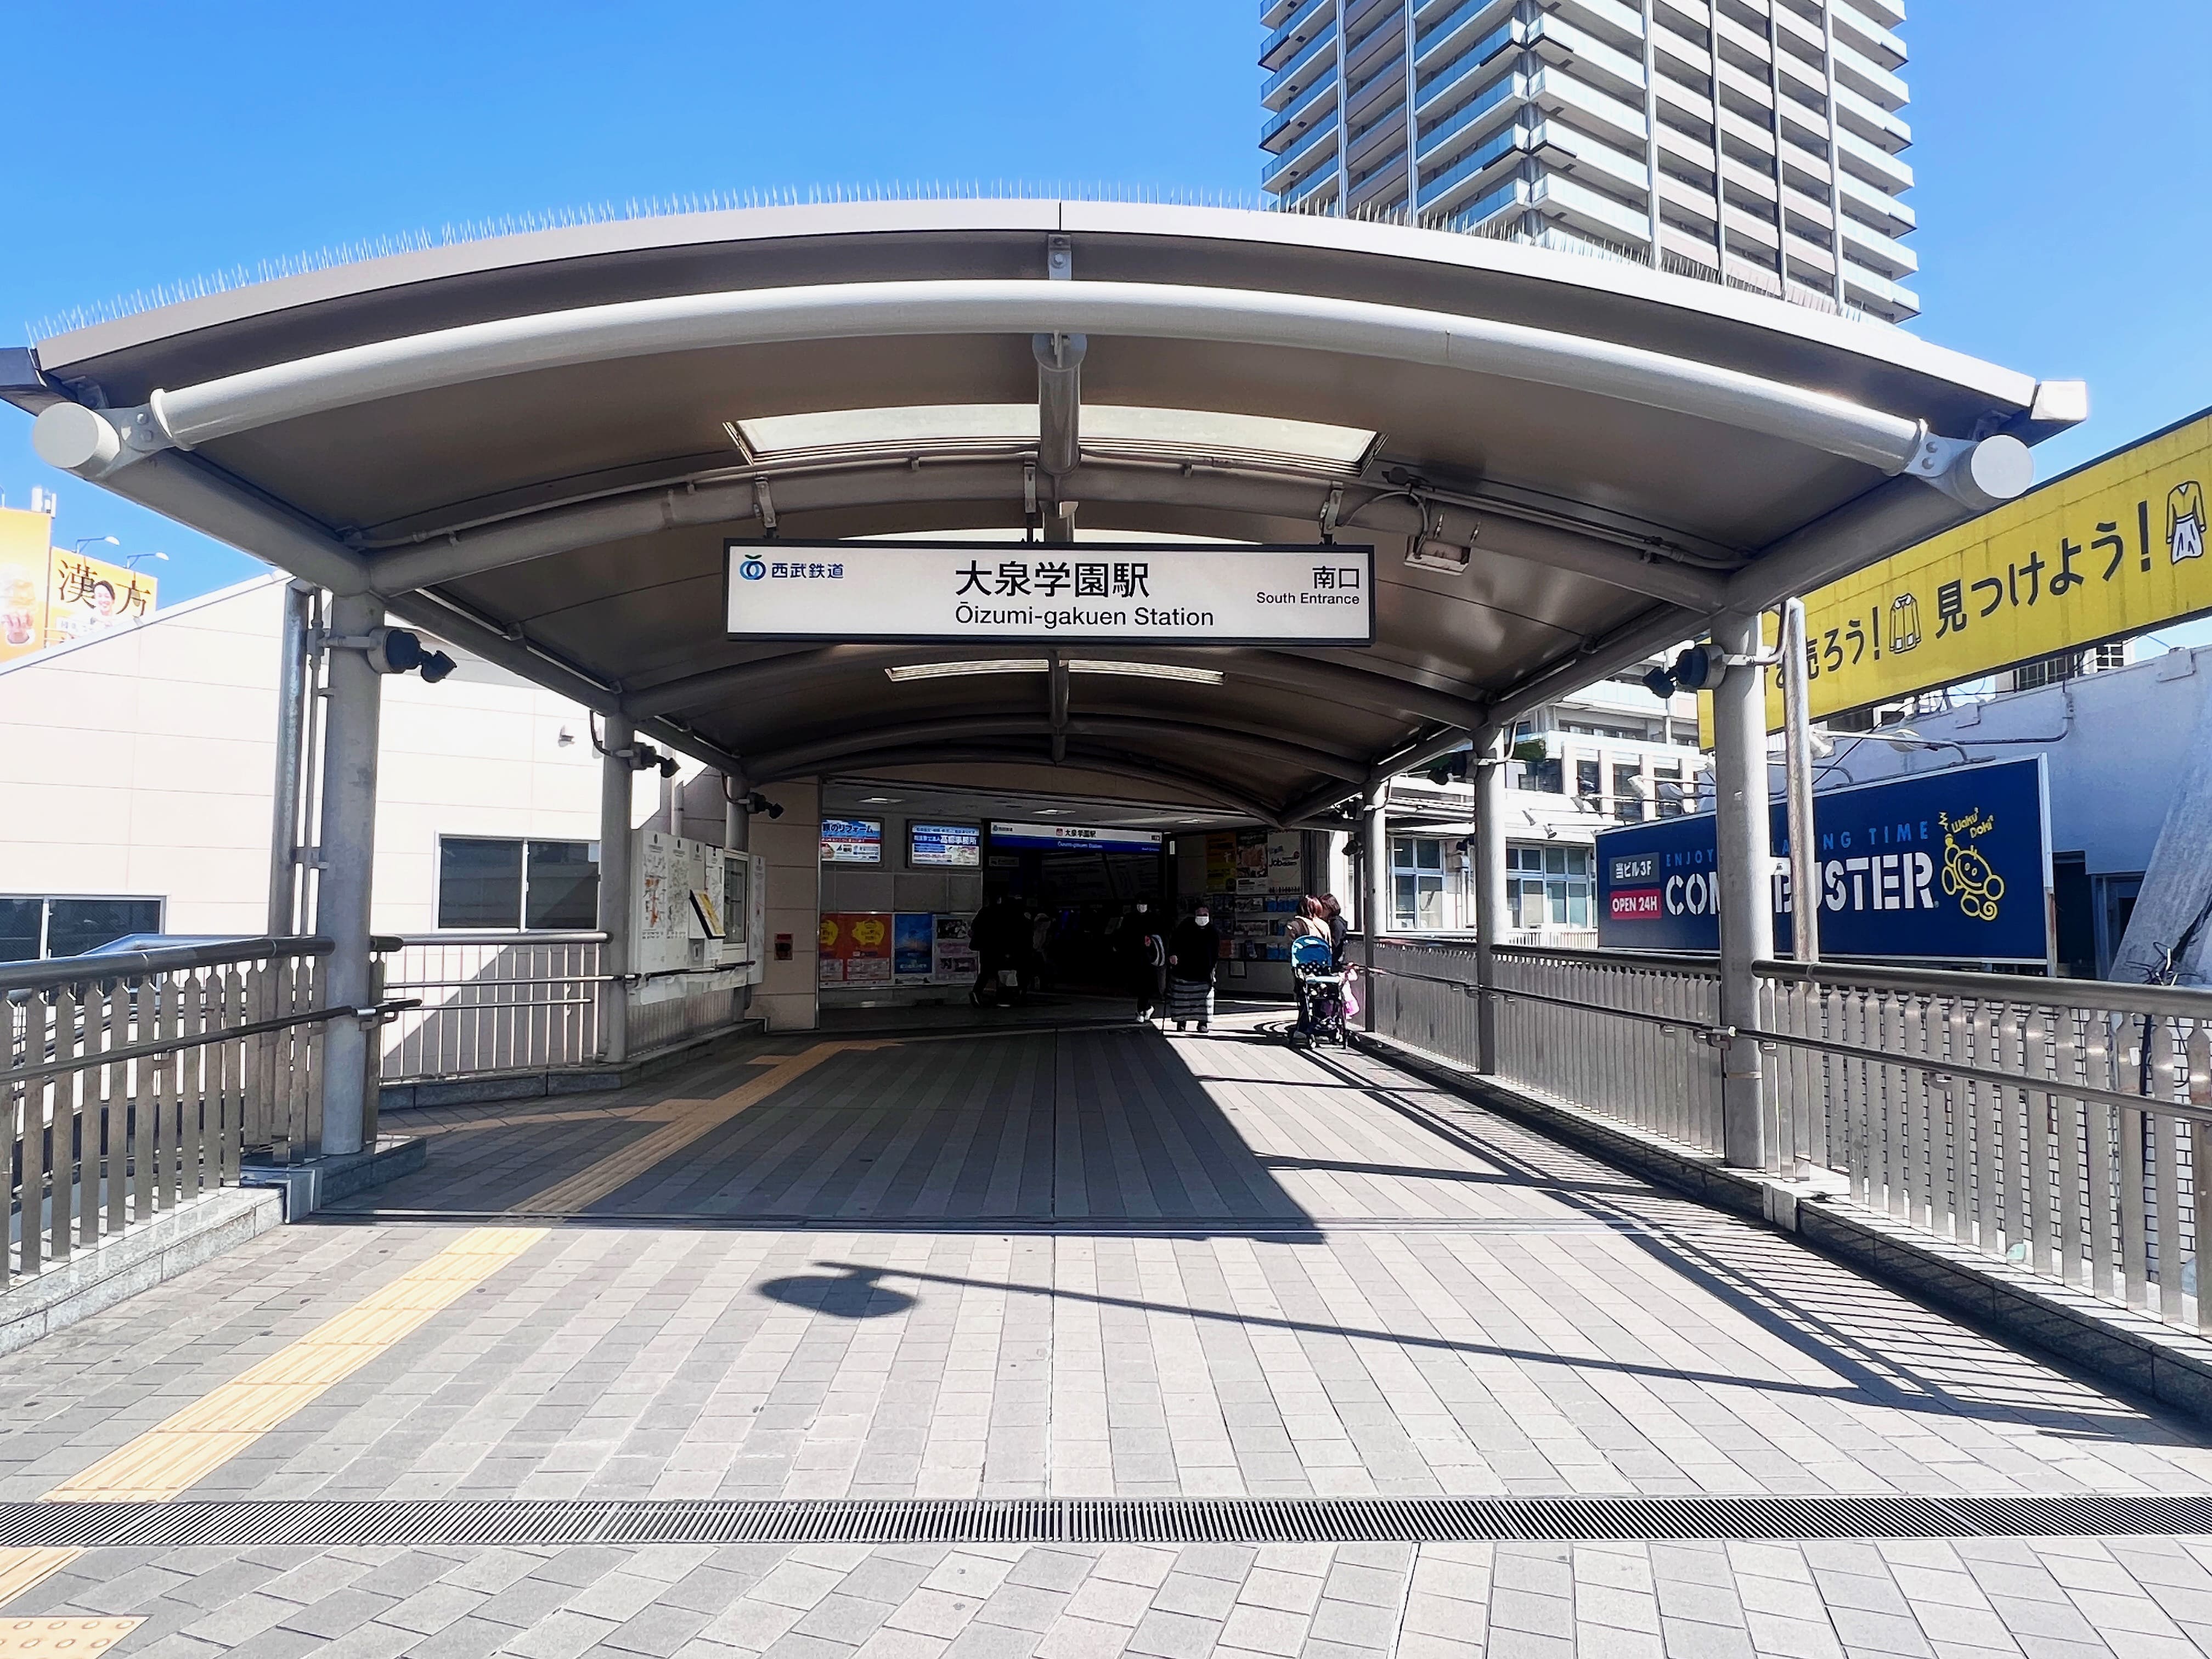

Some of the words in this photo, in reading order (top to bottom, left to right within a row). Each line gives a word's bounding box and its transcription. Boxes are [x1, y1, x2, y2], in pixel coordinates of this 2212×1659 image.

[771, 562, 844, 579] 西武鉄道
[955, 560, 1150, 598] 大泉学園駅
[1312, 566, 1360, 589] 南口
[1935, 500, 2151, 639] 見つけよう!
[58, 560, 151, 618] 漢方
[1256, 592, 1296, 603] South
[1300, 592, 1360, 605] Entrance
[956, 601, 1126, 630] Ōizumi-gakuen
[1134, 607, 1214, 626] Station
[1666, 849, 1714, 867] ENJOY
[1869, 821, 1928, 845] TIME
[1612, 897, 1636, 912] OPEN
[1639, 896, 1657, 911] 24H
